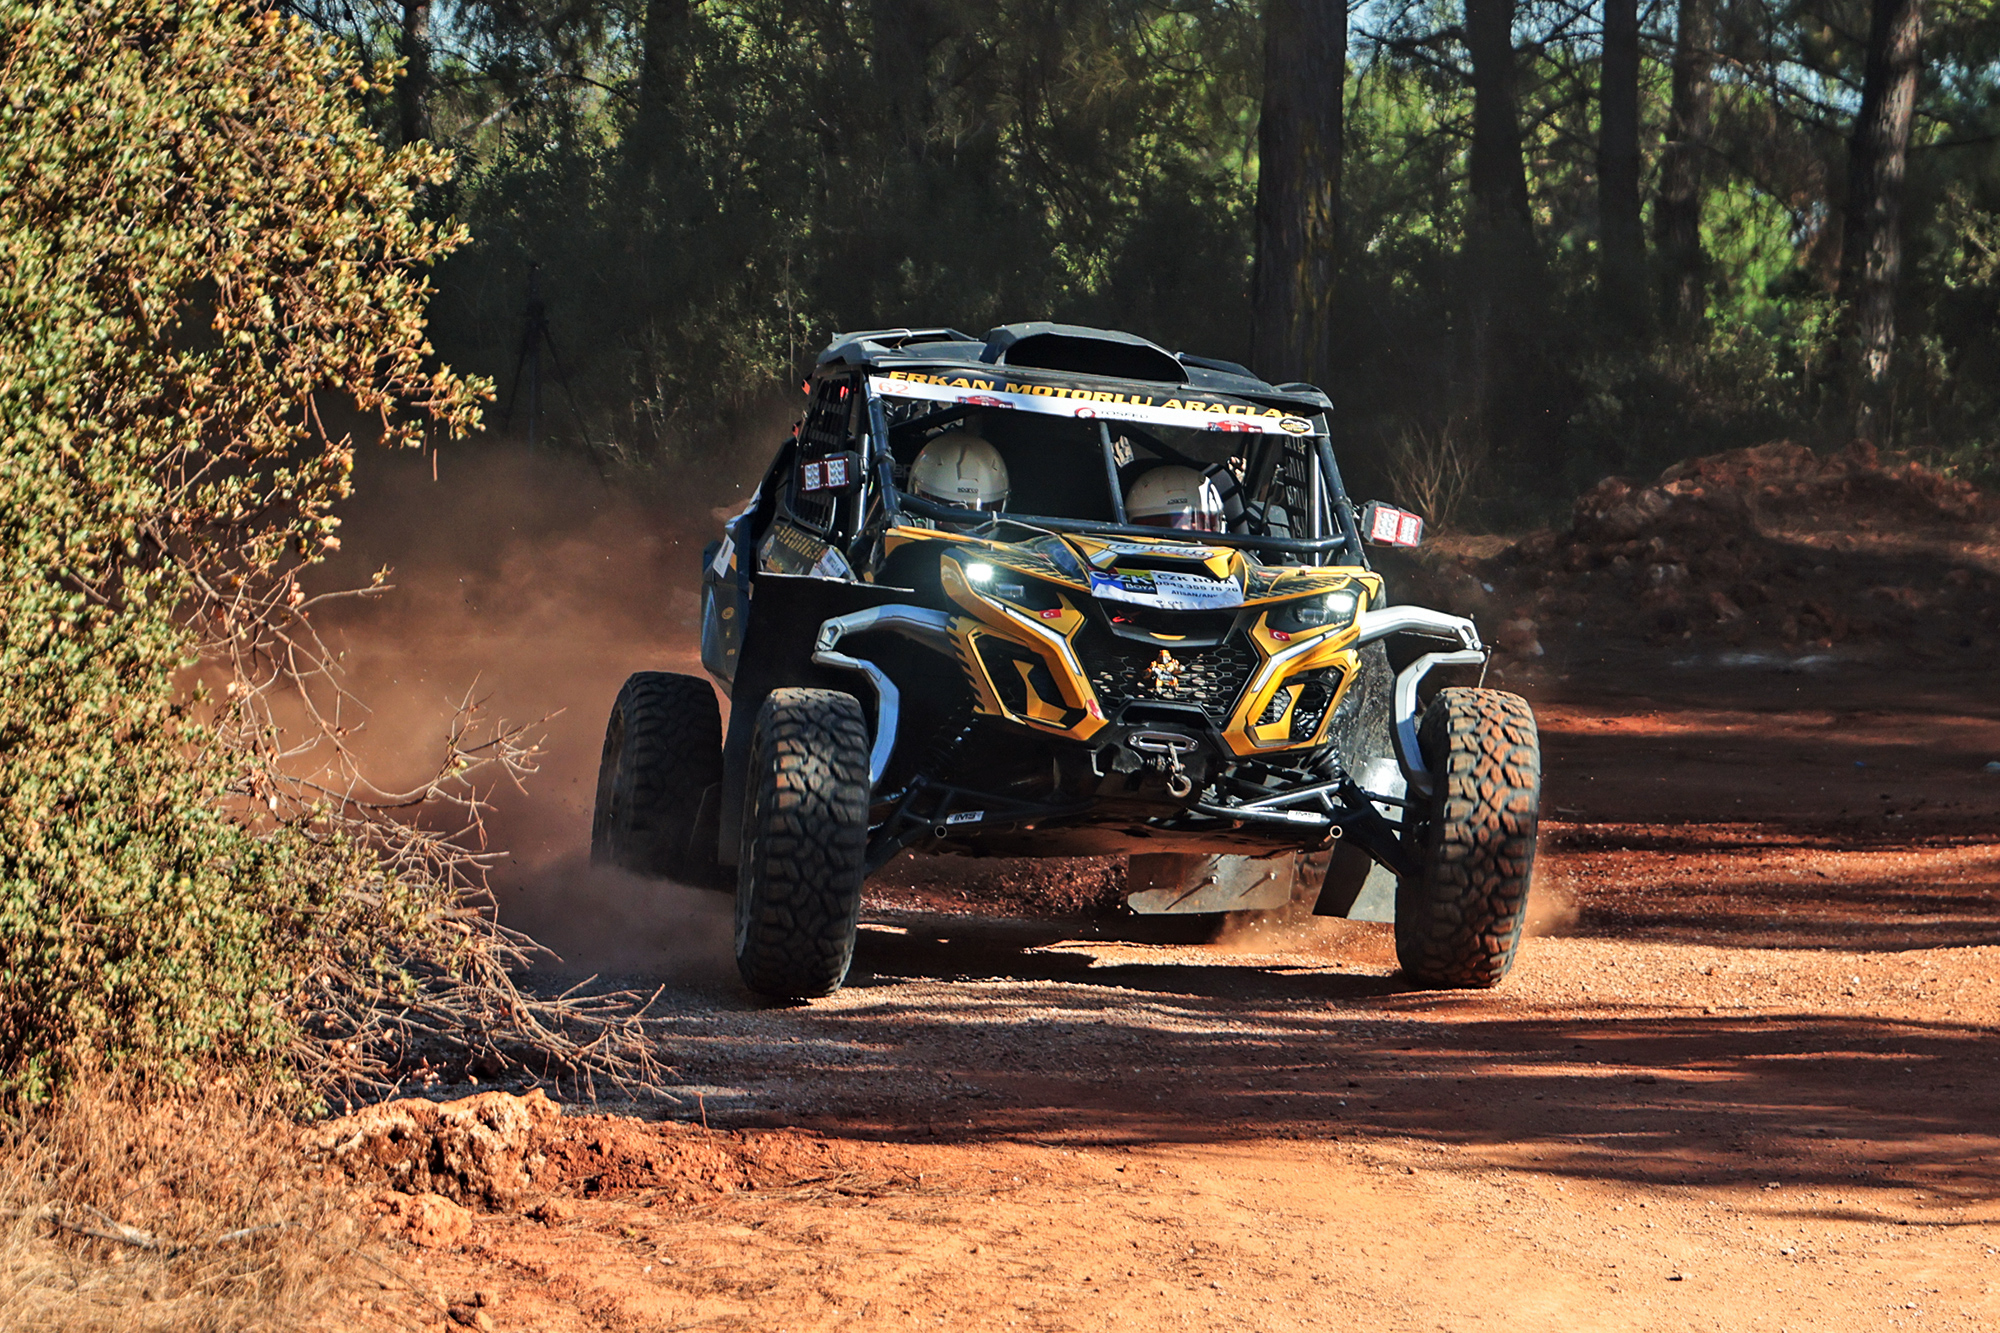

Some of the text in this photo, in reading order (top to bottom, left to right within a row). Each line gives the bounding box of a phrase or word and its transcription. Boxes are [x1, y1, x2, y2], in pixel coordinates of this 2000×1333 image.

[878, 381, 910, 396] 62
[888, 371, 995, 391] ERKAN
[1004, 382, 1153, 407] MOTORLU
[1089, 571, 1153, 585] CZK
[1157, 574, 1189, 582] CZK
[1125, 583, 1156, 591] BOYA
